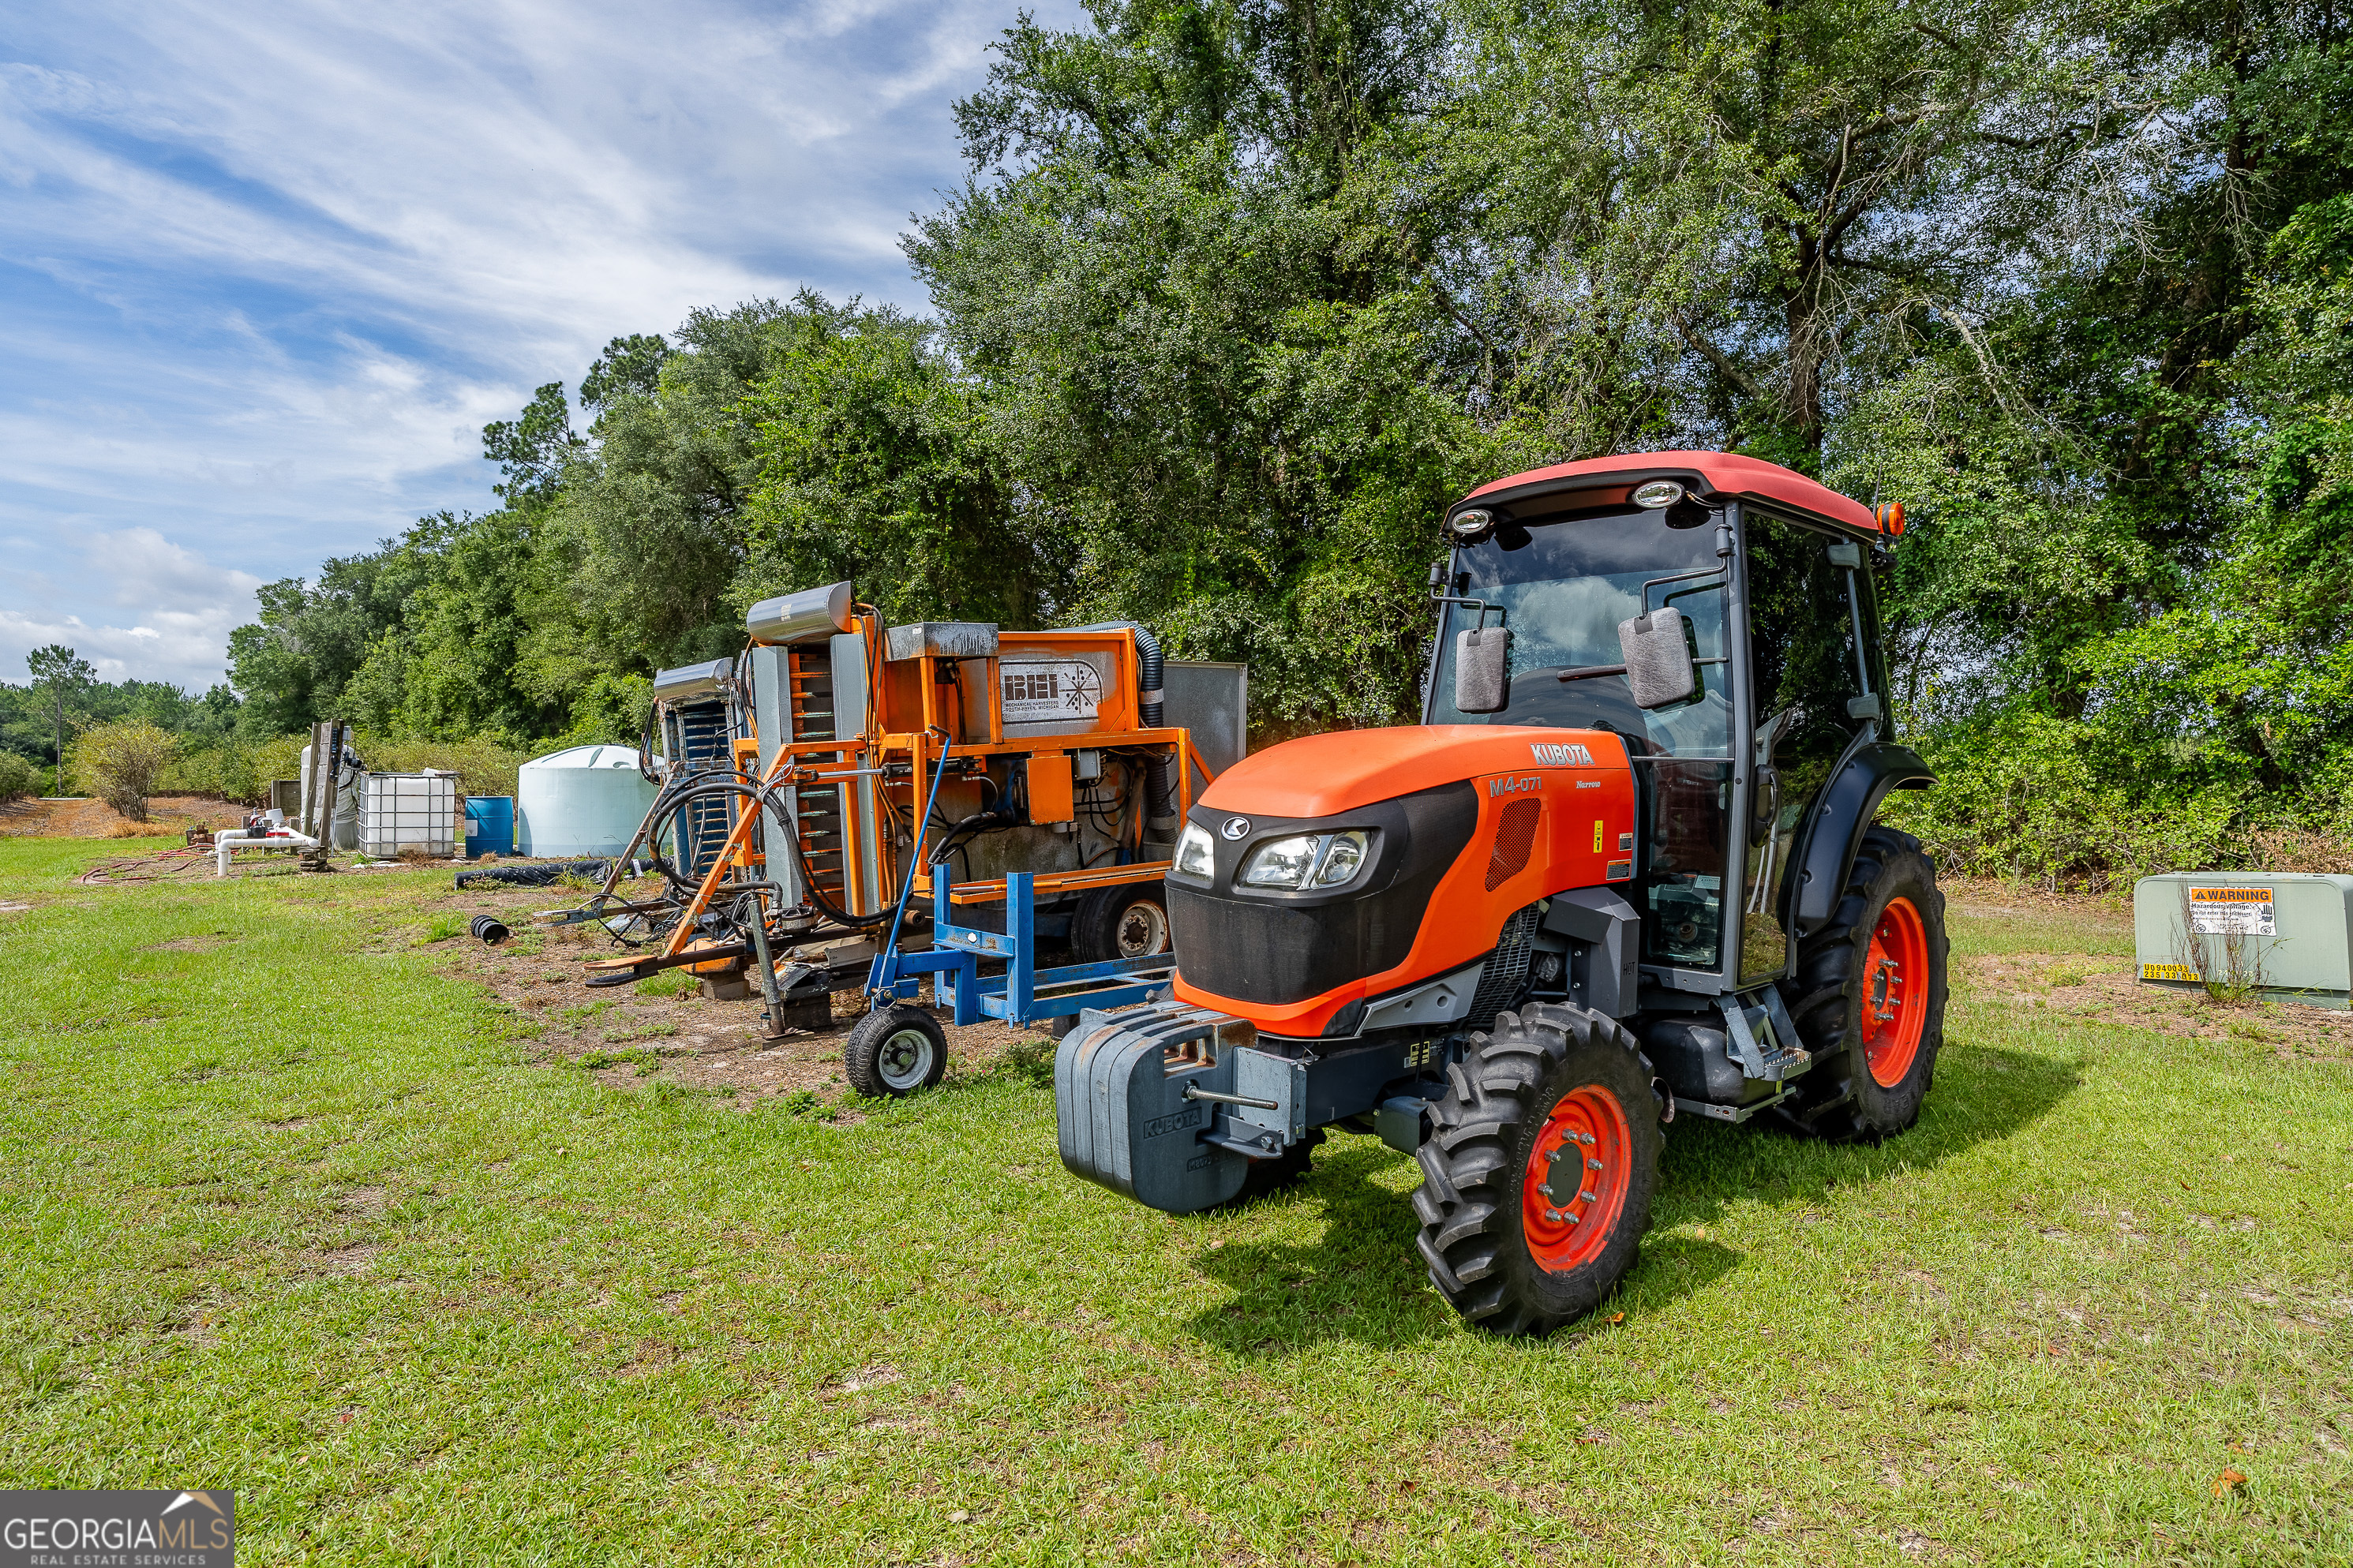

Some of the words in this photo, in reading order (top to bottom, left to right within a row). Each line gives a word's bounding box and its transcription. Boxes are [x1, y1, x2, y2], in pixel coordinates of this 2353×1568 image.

[1005, 674, 1058, 701] BEI
[1530, 743, 1595, 765] KUBOTA
[1489, 776, 1542, 798] M4-071
[1576, 780, 1601, 789] Narrow
[2207, 890, 2269, 900] WARNING
[1623, 961, 1635, 975] HOT
[2144, 964, 2188, 973] U0940033
[1145, 1110, 1200, 1137] KUBOTA
